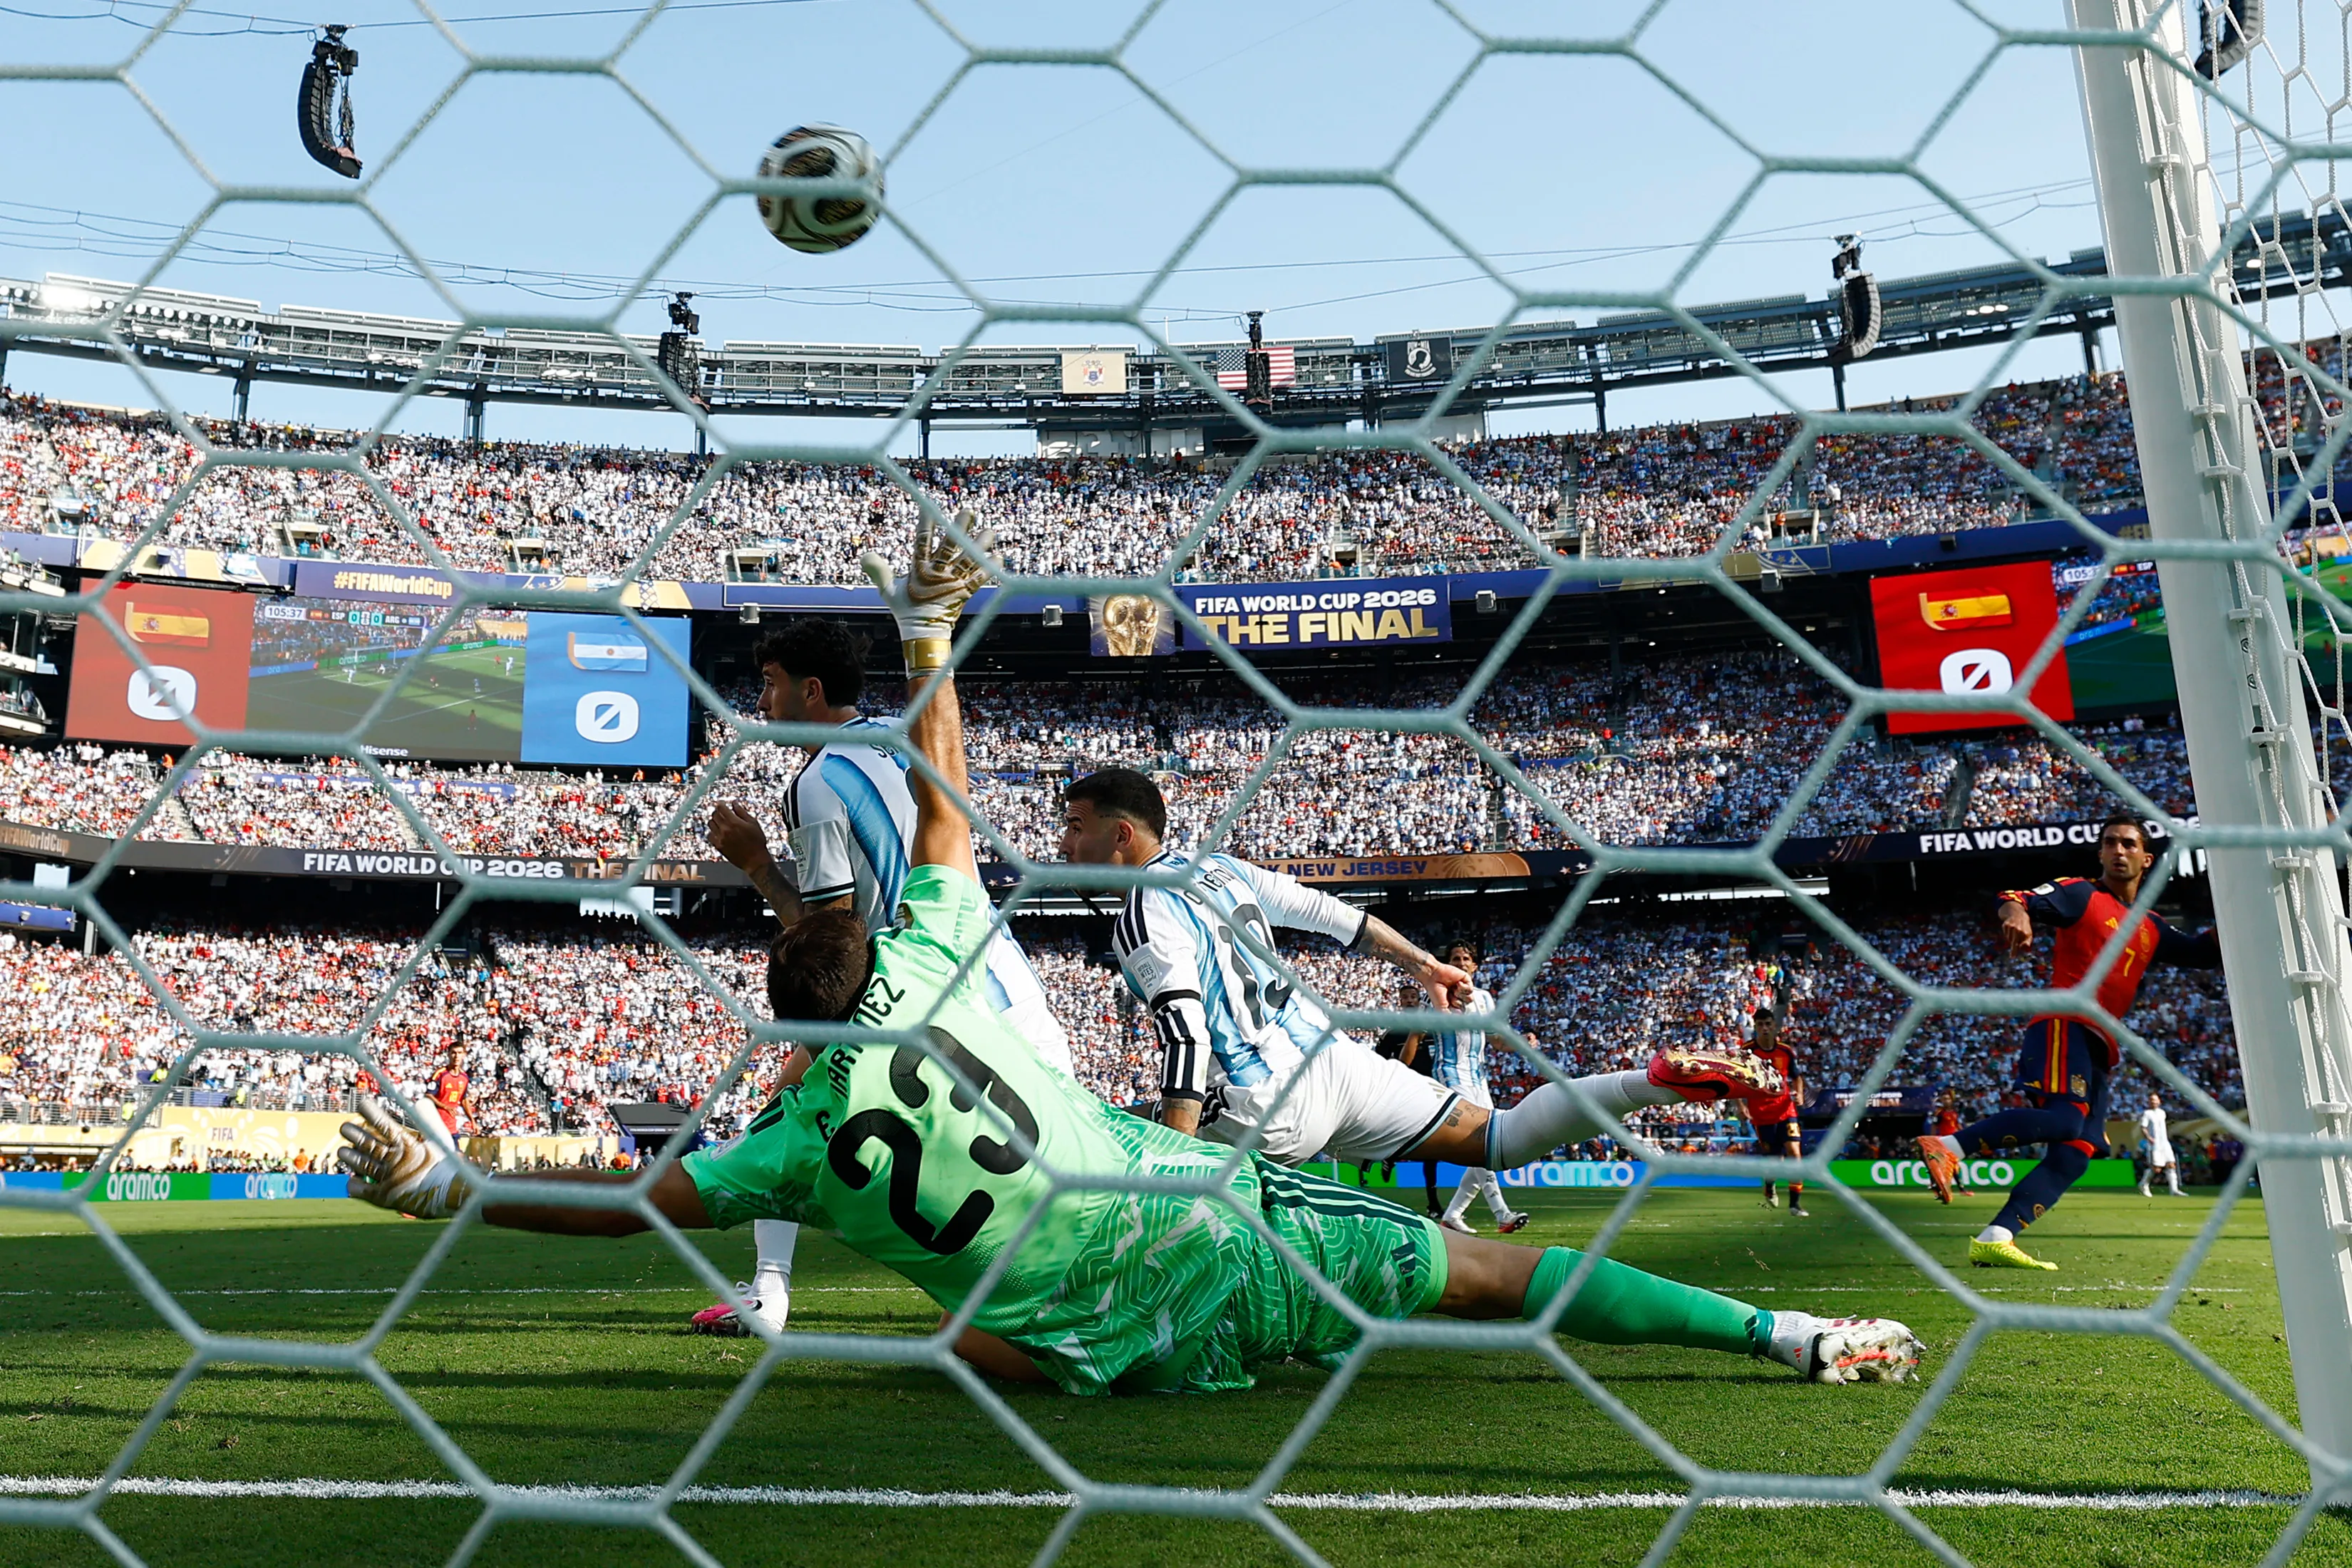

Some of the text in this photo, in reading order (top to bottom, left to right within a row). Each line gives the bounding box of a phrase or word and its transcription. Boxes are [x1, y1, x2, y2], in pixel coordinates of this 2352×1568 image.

[334, 571, 453, 599] #FIFAWorldCup
[267, 607, 303, 619] 105:37
[331, 612, 346, 620] ESP
[350, 614, 358, 623] 0
[373, 614, 380, 624] 0
[1195, 589, 1437, 614] FIFA WORLD CUP 2026
[1197, 607, 1439, 644] THE FINAL
[360, 744, 408, 757] Hisense
[1919, 835, 1973, 854] FIFA
[1976, 827, 2064, 850] WORLD
[2068, 822, 2103, 845] CU
[304, 853, 706, 881] FIFA WORLD CUP 2026 THE FINAL
[1287, 863, 1336, 877] NEW
[1342, 861, 1428, 876] JERSEY
[2125, 947, 2135, 977] 7
[212, 1128, 233, 1141] FIFA
[827, 1025, 1040, 1256] 23
[106, 1173, 170, 1201] aramco
[244, 1172, 297, 1200] aramco
[1503, 1162, 1634, 1187] aramco
